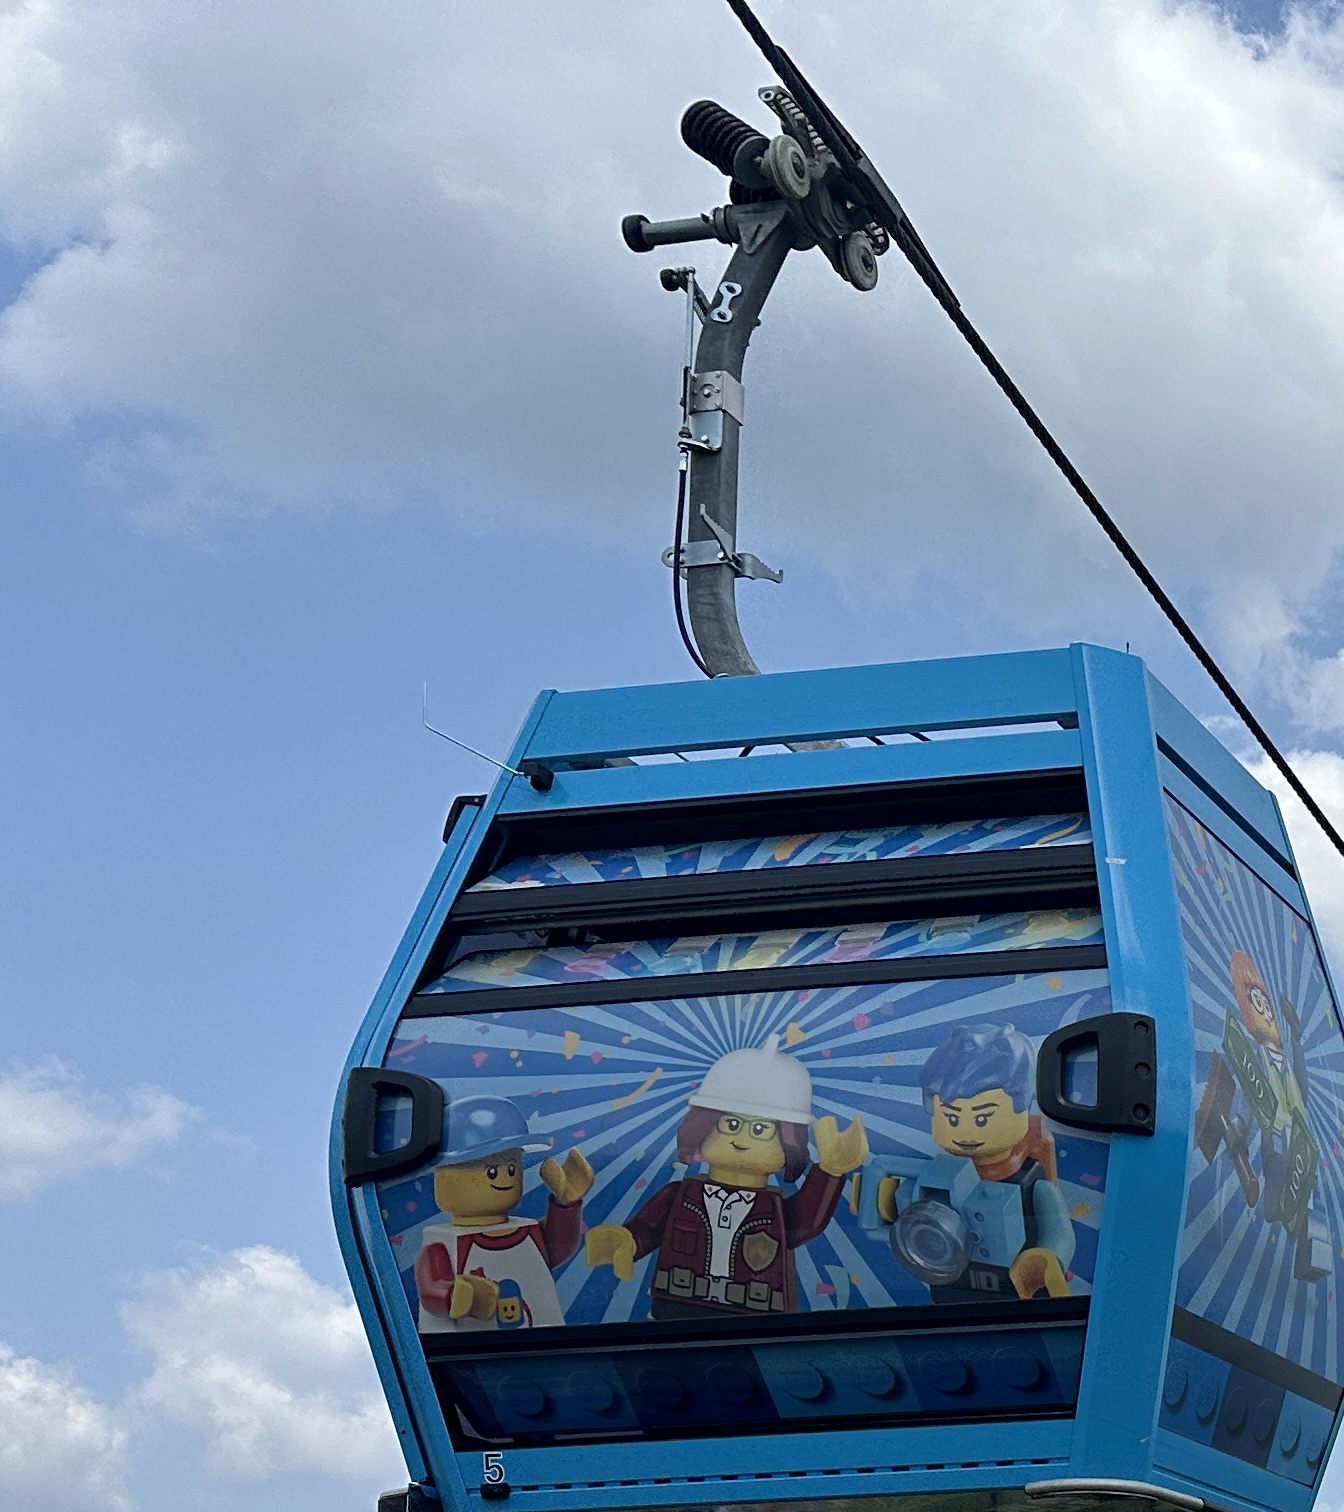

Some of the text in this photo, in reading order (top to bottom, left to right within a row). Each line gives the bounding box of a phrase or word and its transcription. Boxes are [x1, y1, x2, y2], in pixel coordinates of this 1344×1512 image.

[1241, 1050, 1264, 1100] 100
[1289, 1153, 1305, 1201] 100
[482, 1451, 506, 1485] 5
